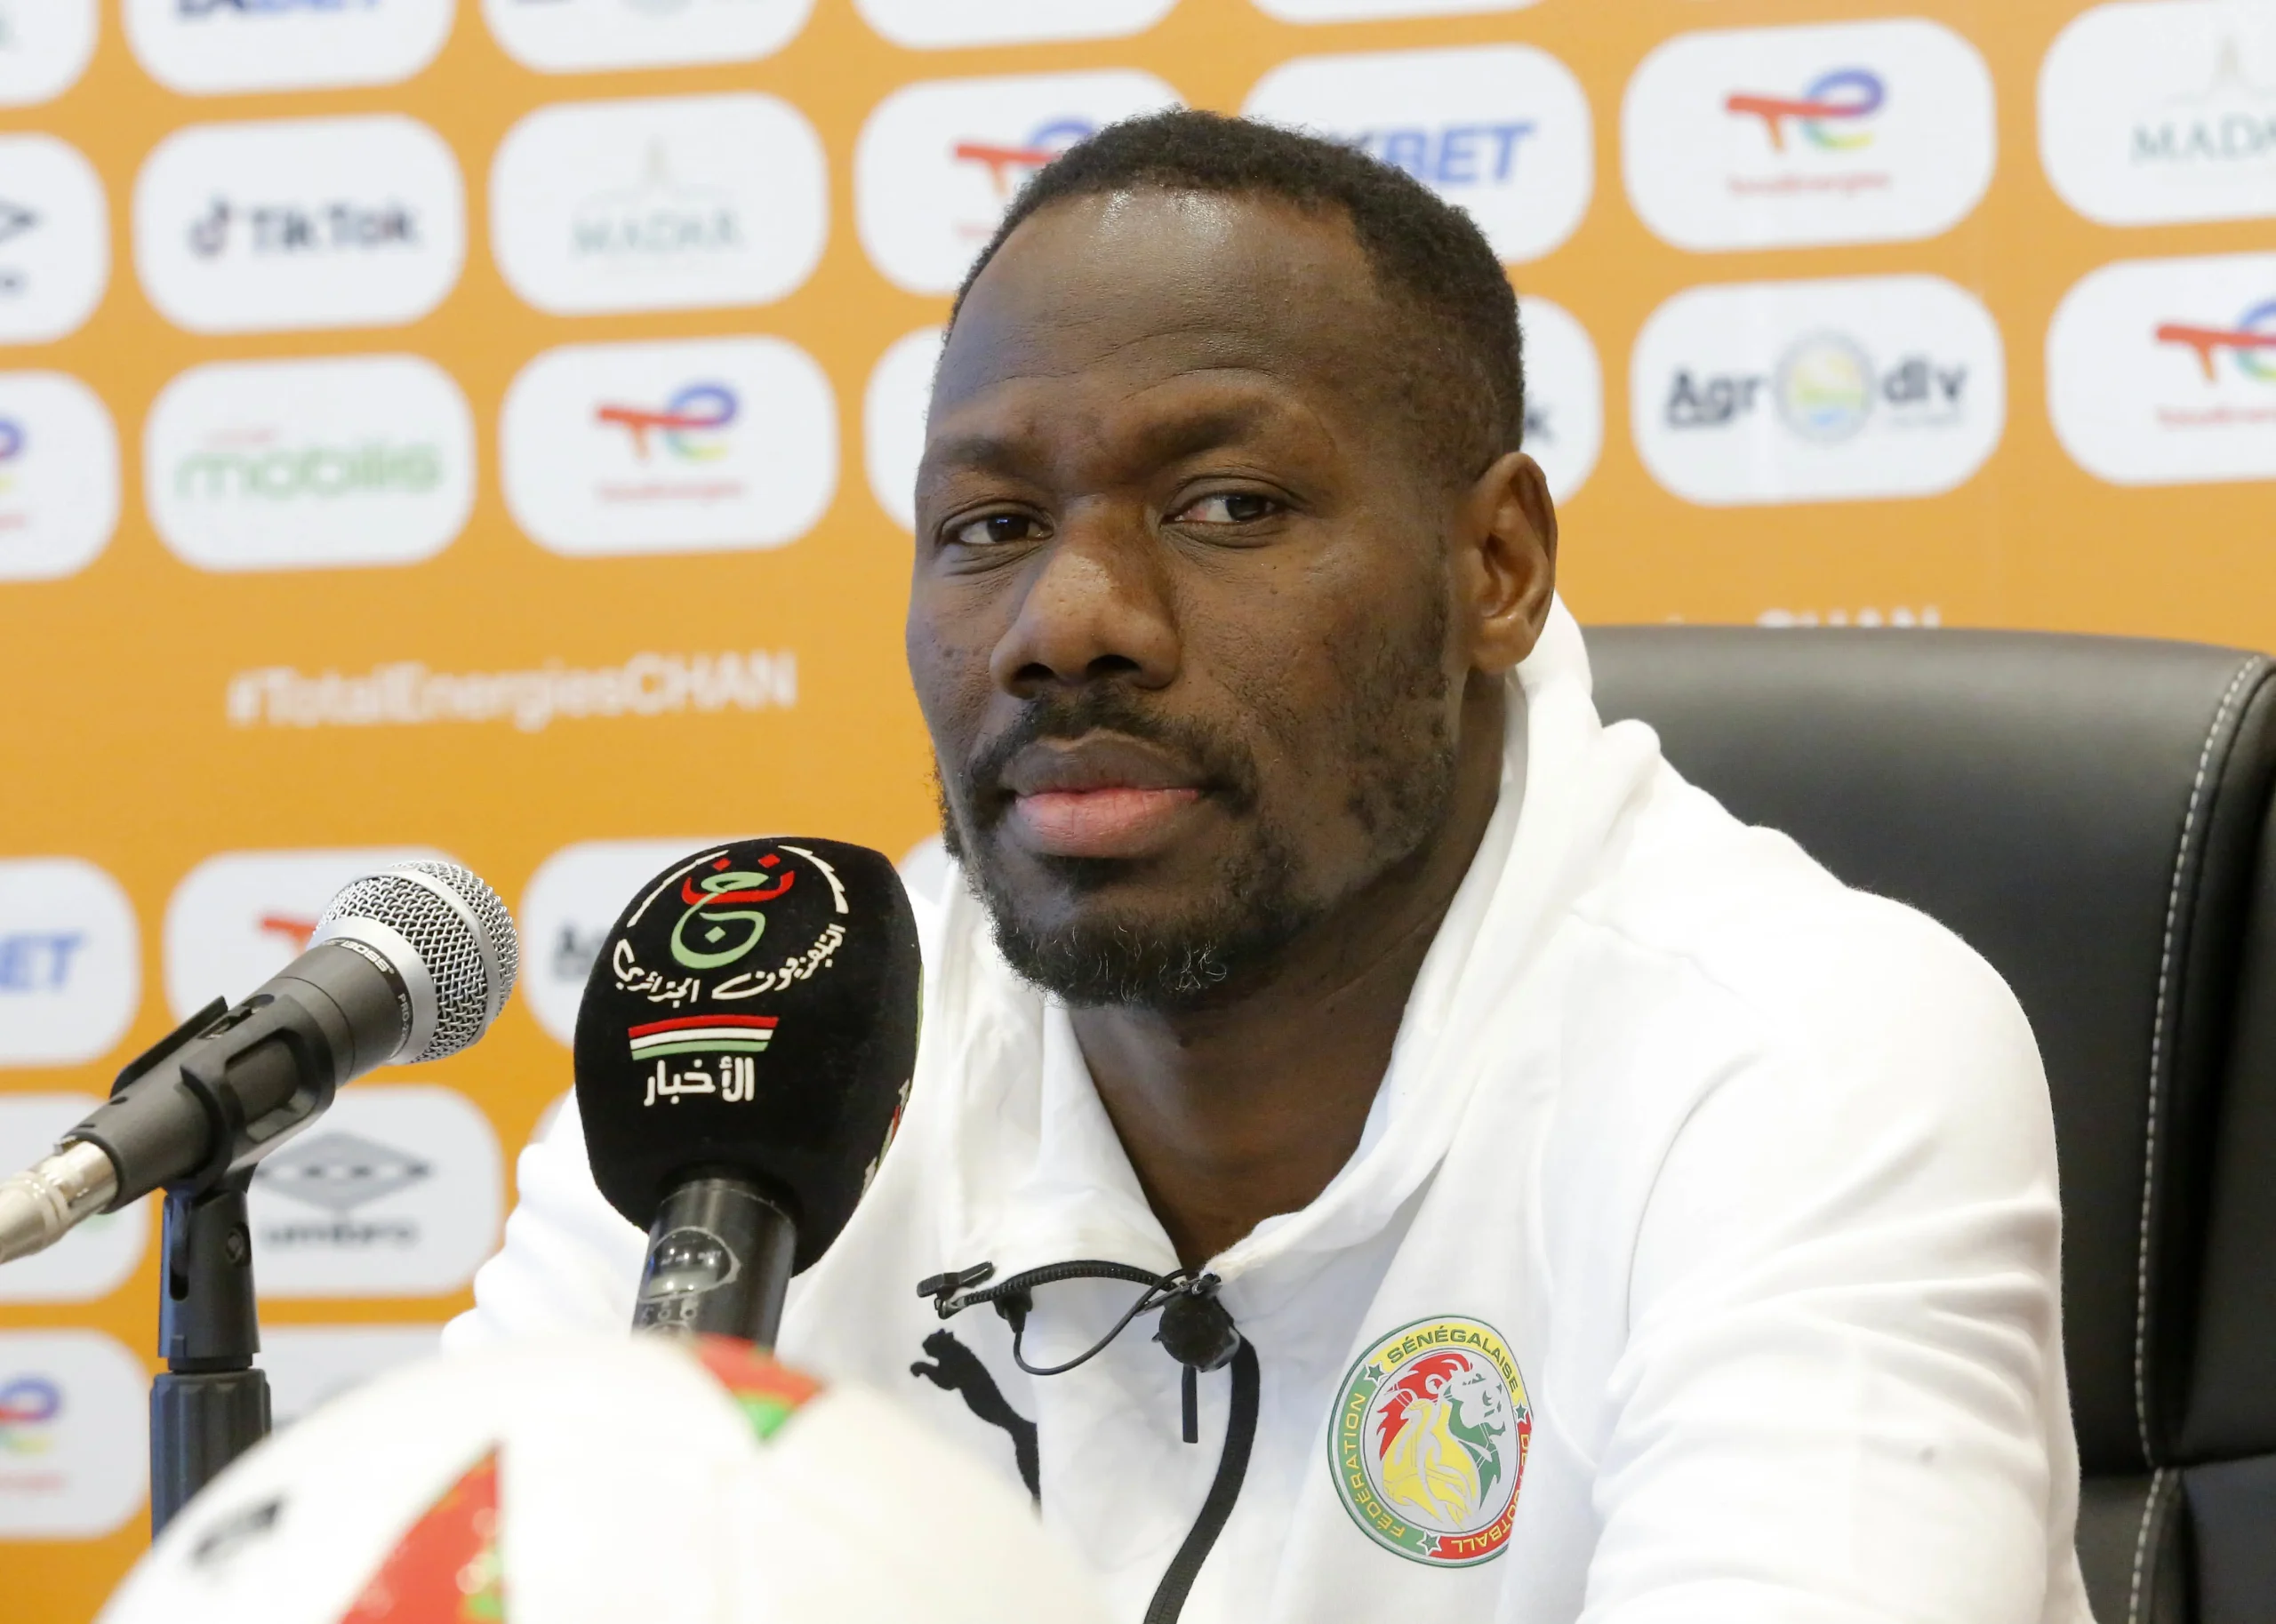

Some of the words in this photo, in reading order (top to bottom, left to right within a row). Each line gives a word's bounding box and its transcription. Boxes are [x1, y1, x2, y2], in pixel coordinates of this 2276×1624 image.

[341, 940, 390, 972] BOSS
[644, 1057, 755, 1106] الأخبار
[1343, 1393, 1406, 1539] FÉDÉRATION
[1387, 1326, 1518, 1393] SÉNÉGALAISE
